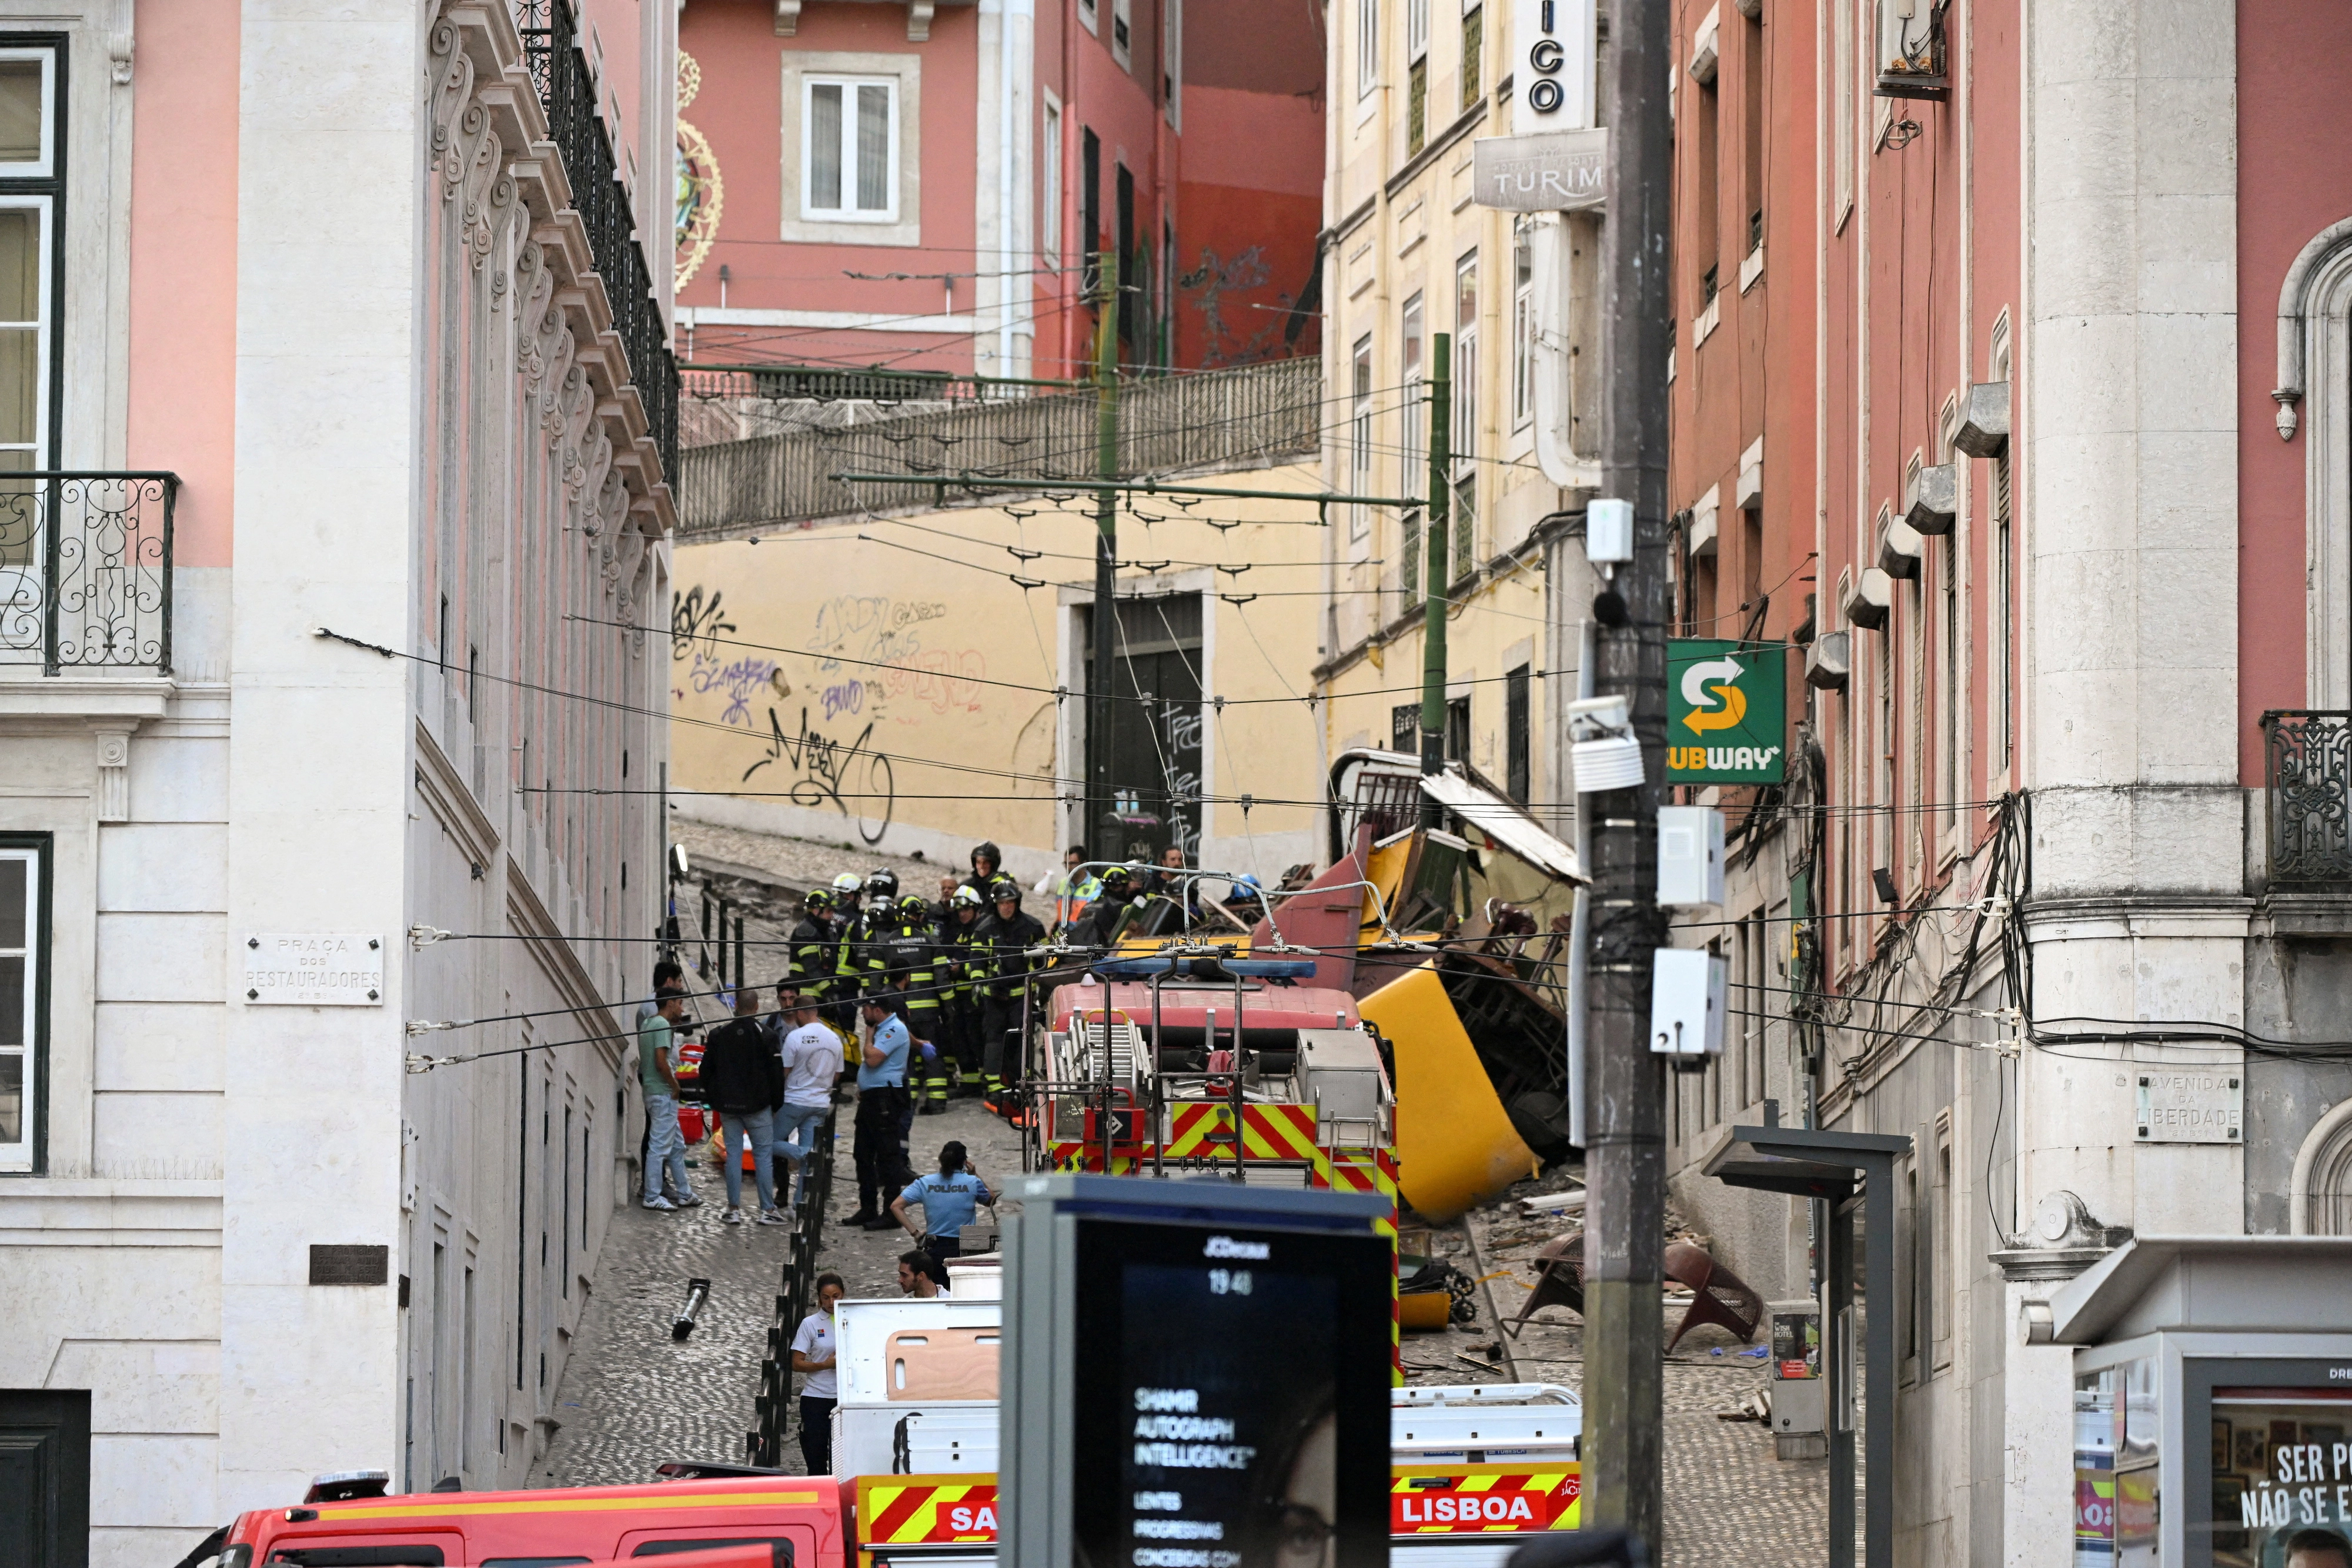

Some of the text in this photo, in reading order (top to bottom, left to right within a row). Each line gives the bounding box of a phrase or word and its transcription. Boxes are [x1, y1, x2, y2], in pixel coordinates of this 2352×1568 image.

[1494, 166, 1603, 198] TURIM
[1666, 745, 1780, 770] UBWAY
[278, 940, 348, 957] PRAÇA
[246, 971, 380, 988] RESTAURADORES
[2149, 1077, 2227, 1090] AVENIDA
[2179, 1095, 2195, 1104] DA
[2136, 1108, 2240, 1126] LIBERDADE
[2277, 1443, 2324, 1484] SER
[1402, 1496, 1533, 1522] LISBOA
[2241, 1480, 2291, 1529] NÃO
[2298, 1486, 2329, 1525] SE
